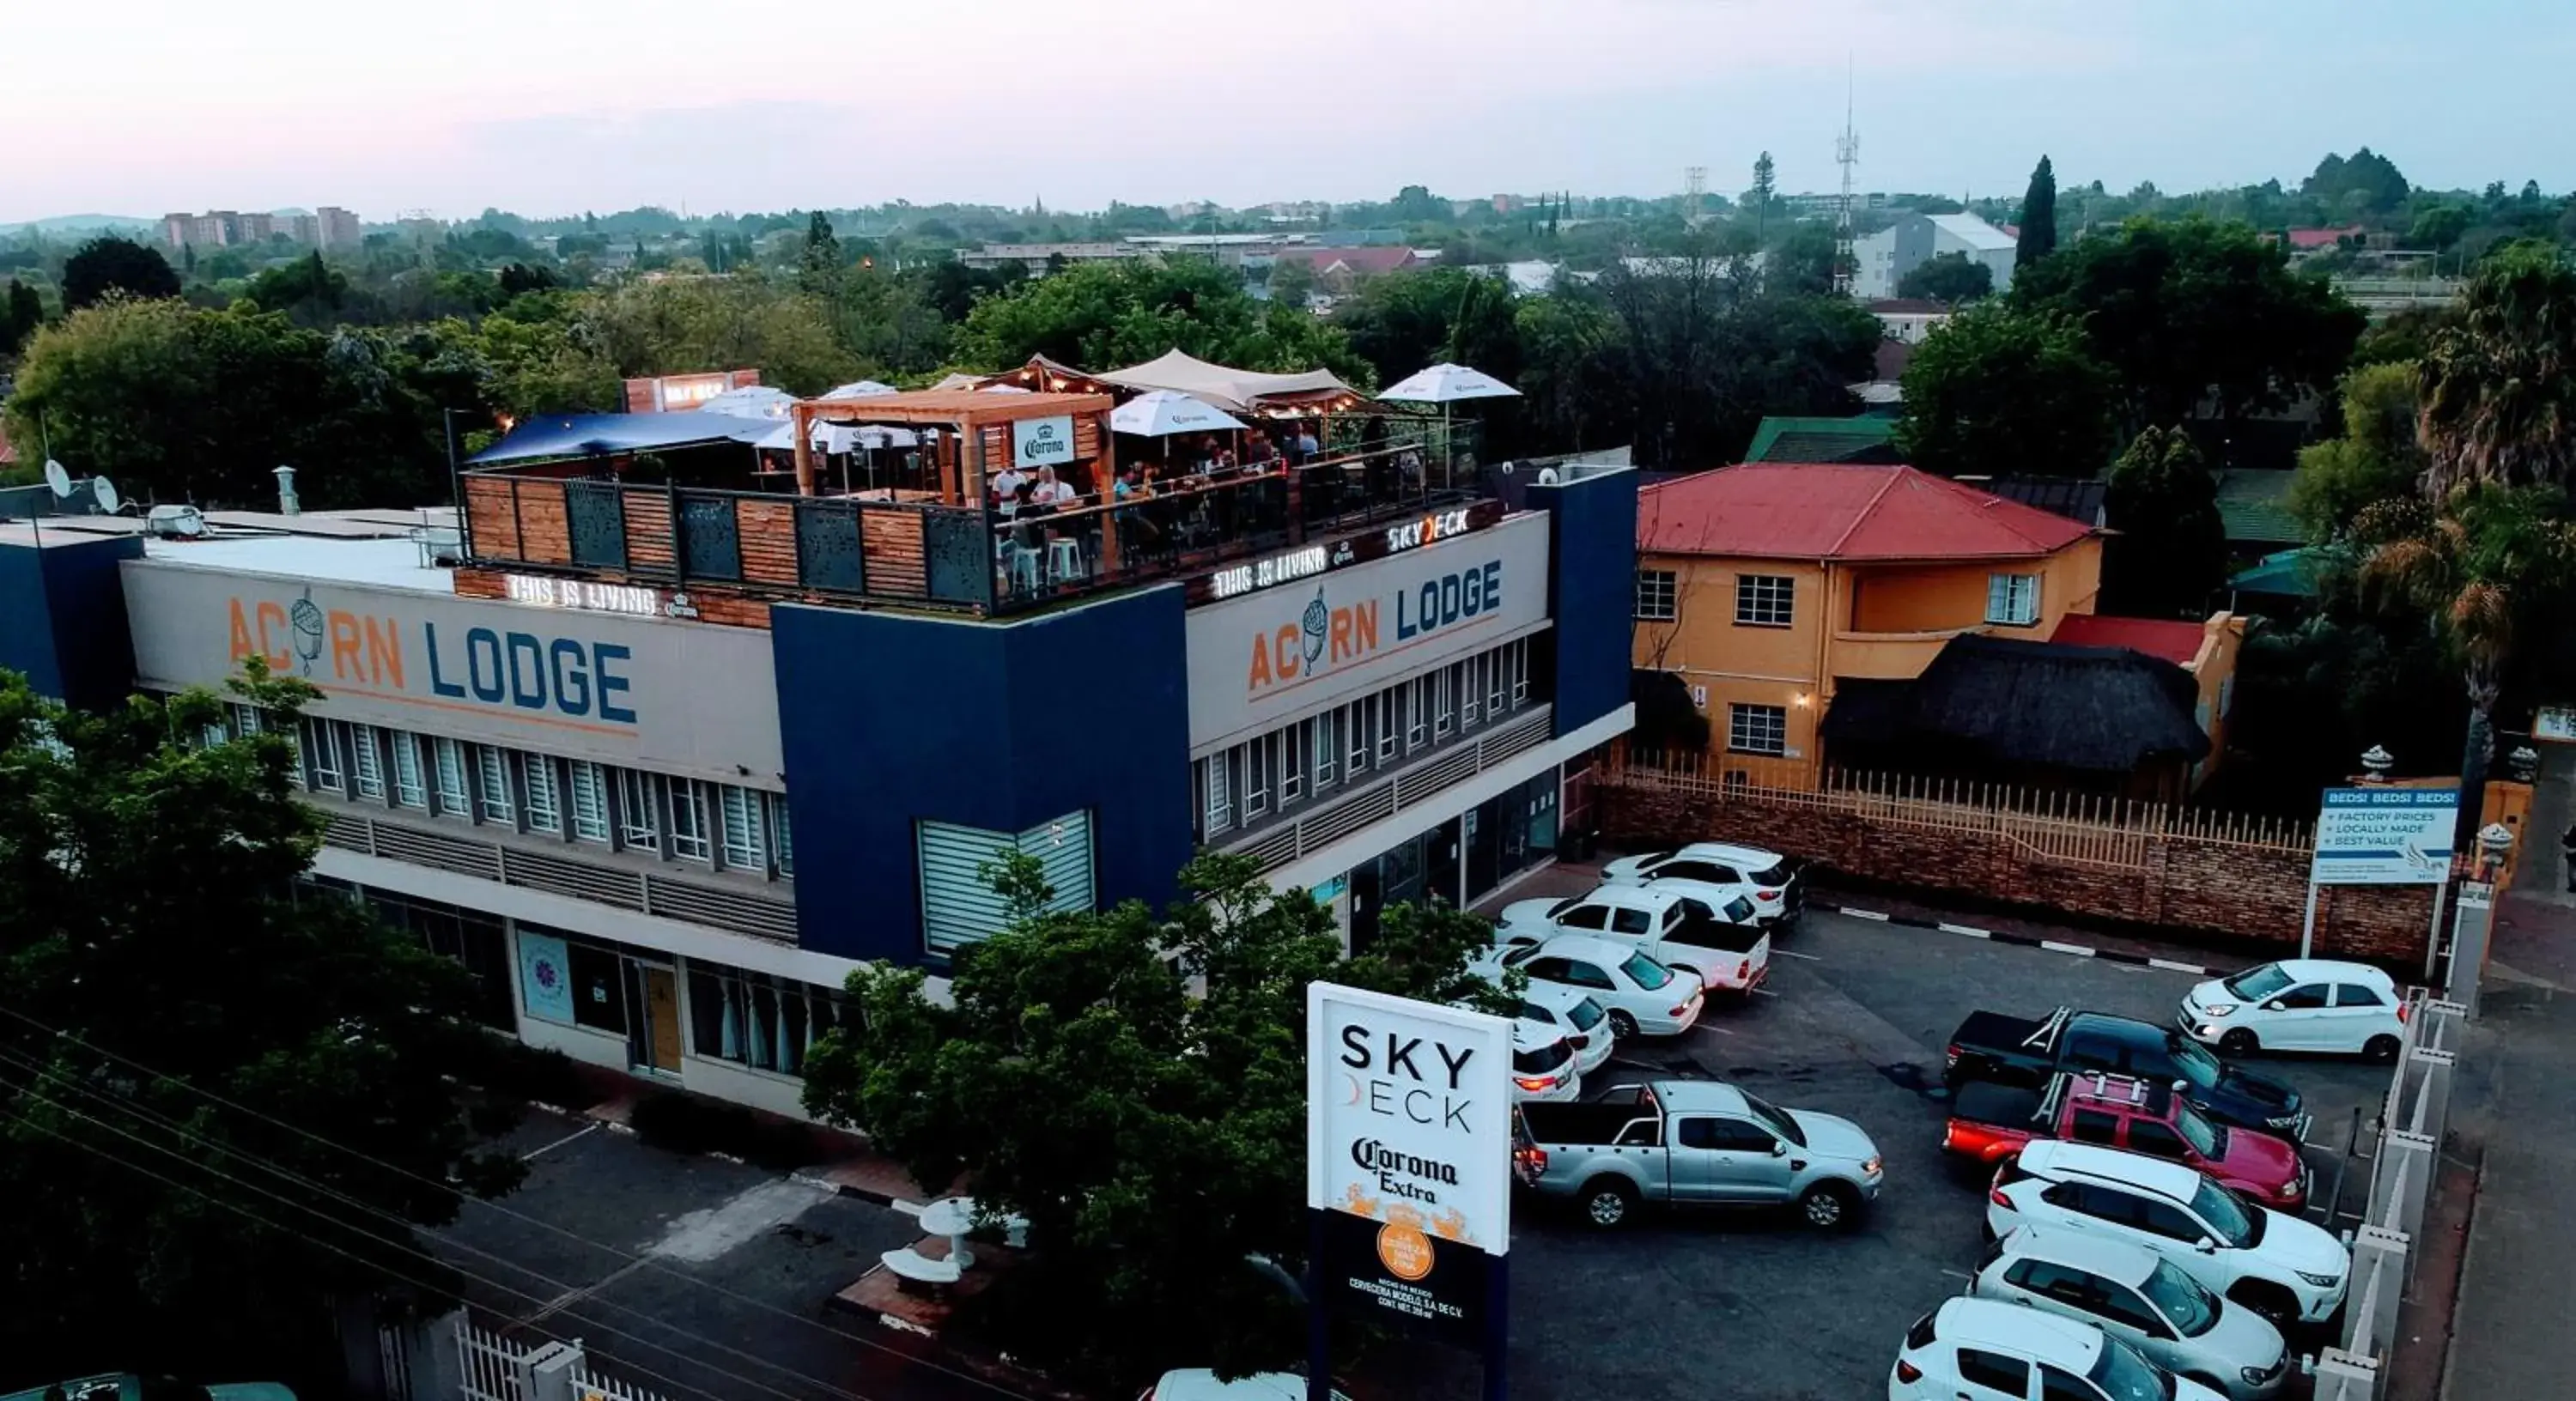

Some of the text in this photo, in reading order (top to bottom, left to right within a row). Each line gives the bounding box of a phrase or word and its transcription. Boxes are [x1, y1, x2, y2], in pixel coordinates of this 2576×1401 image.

[1024, 439, 1064, 459] Corona
[506, 574, 656, 615] THIS IS LIVING
[1212, 567, 1252, 597] THIS
[1257, 561, 1273, 585] IS
[1397, 560, 1501, 640] LODGE
[425, 622, 637, 724] LODGE
[2328, 793, 2456, 803] BEDS! BEDS! BEDS!
[2336, 824, 2425, 834] LOCALLY MADE
[2337, 813, 2435, 822] FACTORY PRICES
[2335, 836, 2405, 846] BEST VALUE
[1340, 1024, 1475, 1089] SKY
[1352, 1137, 1459, 1186] Corona
[1380, 1171, 1437, 1204] Extra
